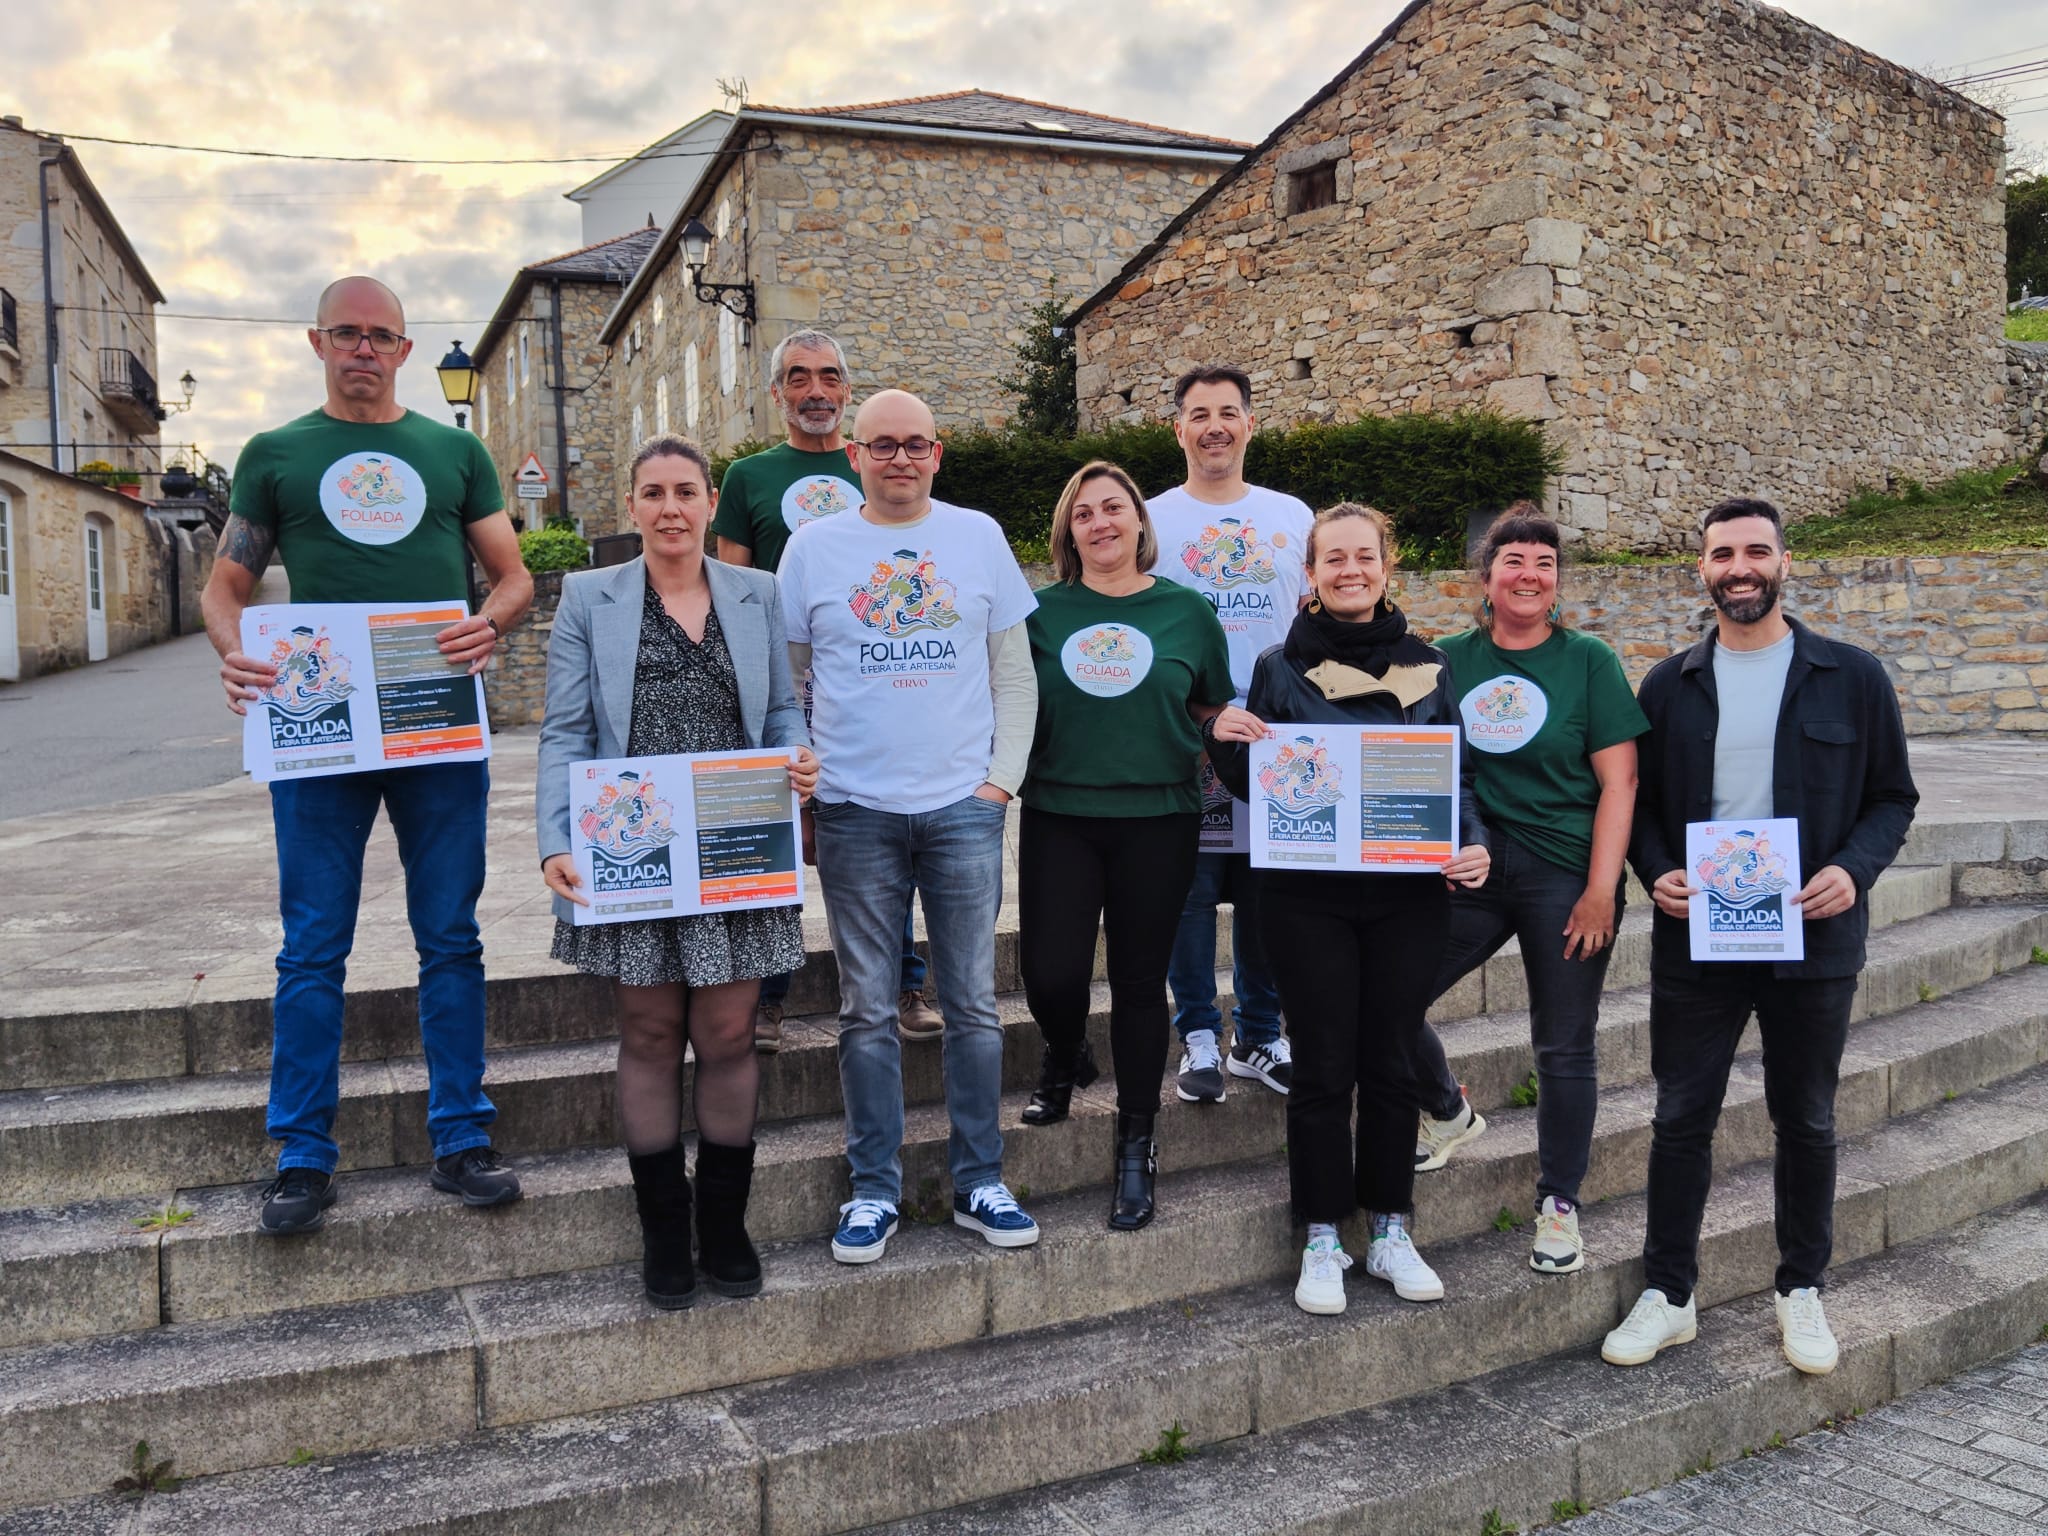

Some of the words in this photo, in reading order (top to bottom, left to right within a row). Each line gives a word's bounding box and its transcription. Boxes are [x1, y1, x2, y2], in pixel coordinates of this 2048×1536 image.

[341, 509, 404, 523] FOLIADA
[1201, 591, 1274, 611] OLIADA
[1220, 610, 1230, 618] DE
[1222, 623, 1248, 633] ERVO
[860, 640, 957, 663] FOLIADA
[860, 666, 867, 674] E
[868, 664, 891, 674] FEIRA
[894, 663, 908, 672] DE
[1076, 663, 1131, 678] FOLIADA
[893, 678, 928, 688] CERVO
[272, 718, 350, 740] FOLIADA
[1471, 723, 1524, 734] FOLIADA
[274, 740, 280, 748] E
[301, 737, 312, 745] DE
[1269, 819, 1334, 835] FOLIADA
[594, 863, 670, 884] FOLIADA
[601, 882, 621, 891] FEIRA
[621, 881, 632, 889] DE
[1711, 909, 1782, 924] FOLIADA
